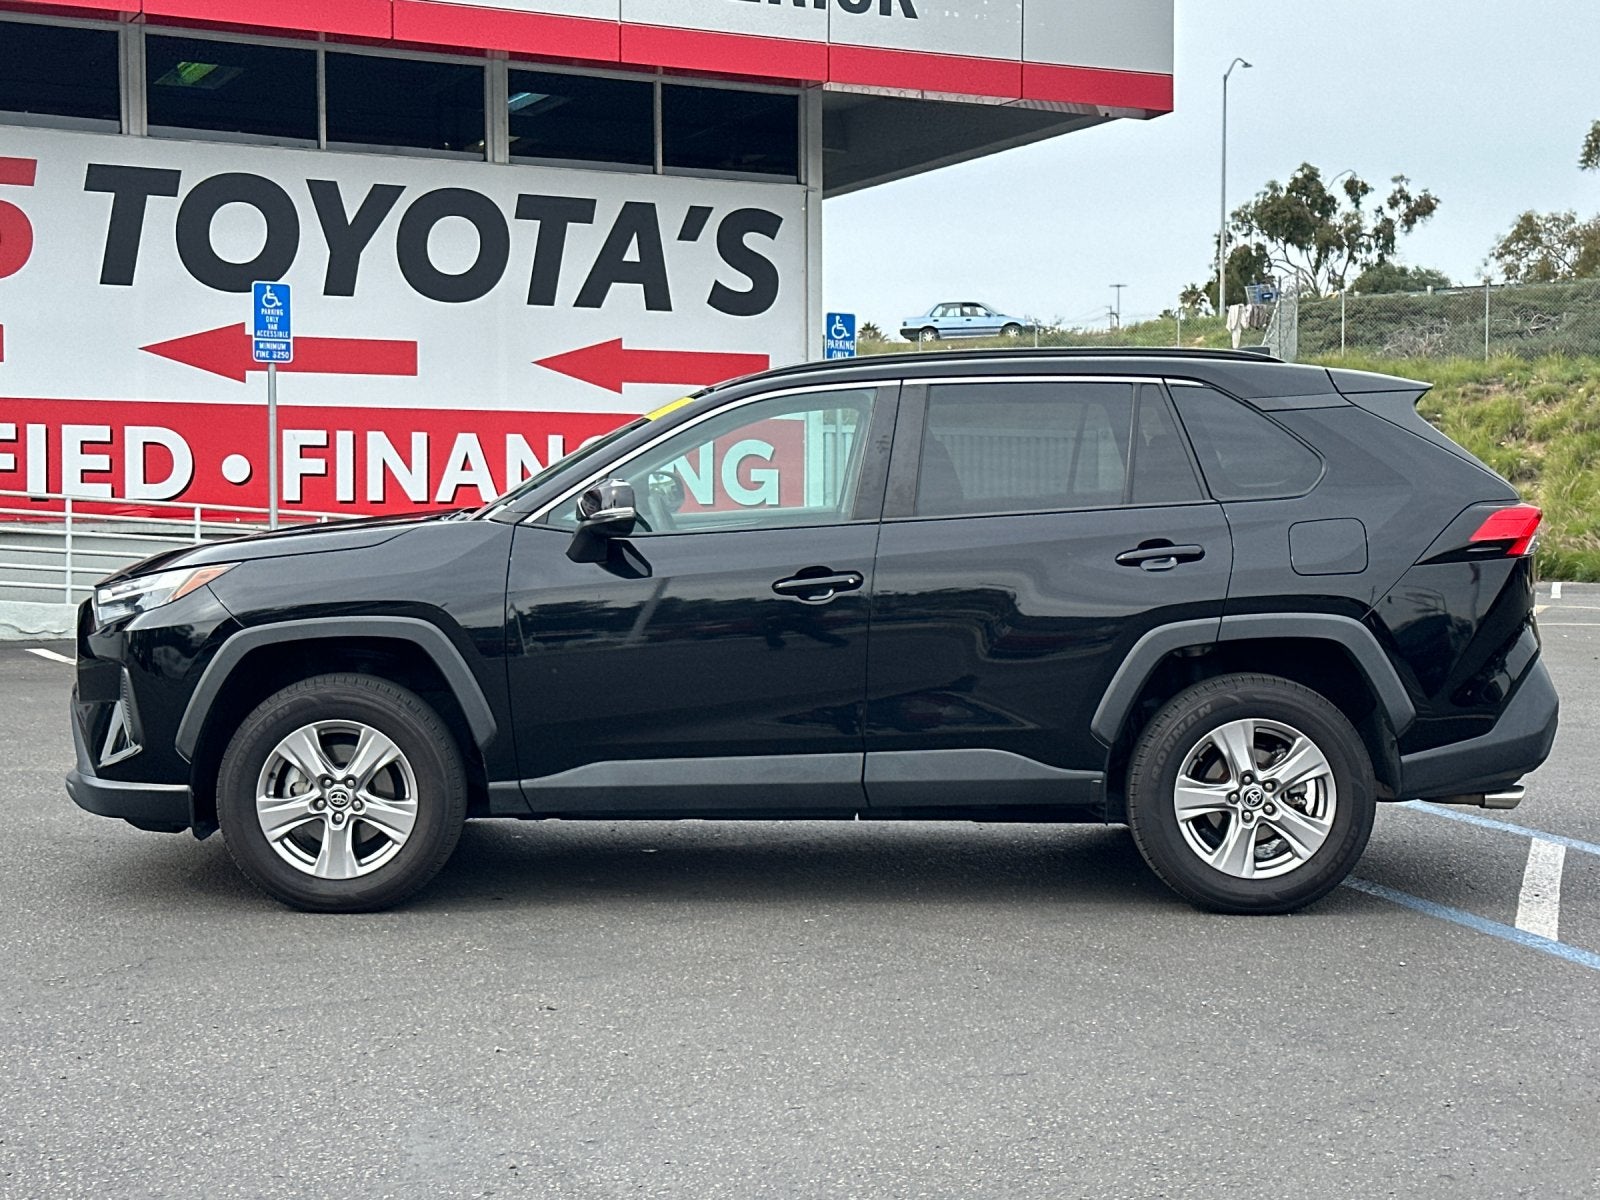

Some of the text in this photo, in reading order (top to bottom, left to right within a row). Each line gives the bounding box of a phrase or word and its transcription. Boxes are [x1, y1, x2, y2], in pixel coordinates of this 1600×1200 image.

[84, 164, 783, 316] TOYOTA'S
[261, 308, 284, 316] PARKING
[265, 315, 279, 323] ONLY
[256, 329, 288, 338] ACCESSIBLE
[259, 342, 287, 350] MINIMUM
[828, 340, 854, 350] PARKING
[255, 350, 270, 358] FINE
[832, 350, 850, 358] ONLY
[282, 428, 780, 507] FINANNG
